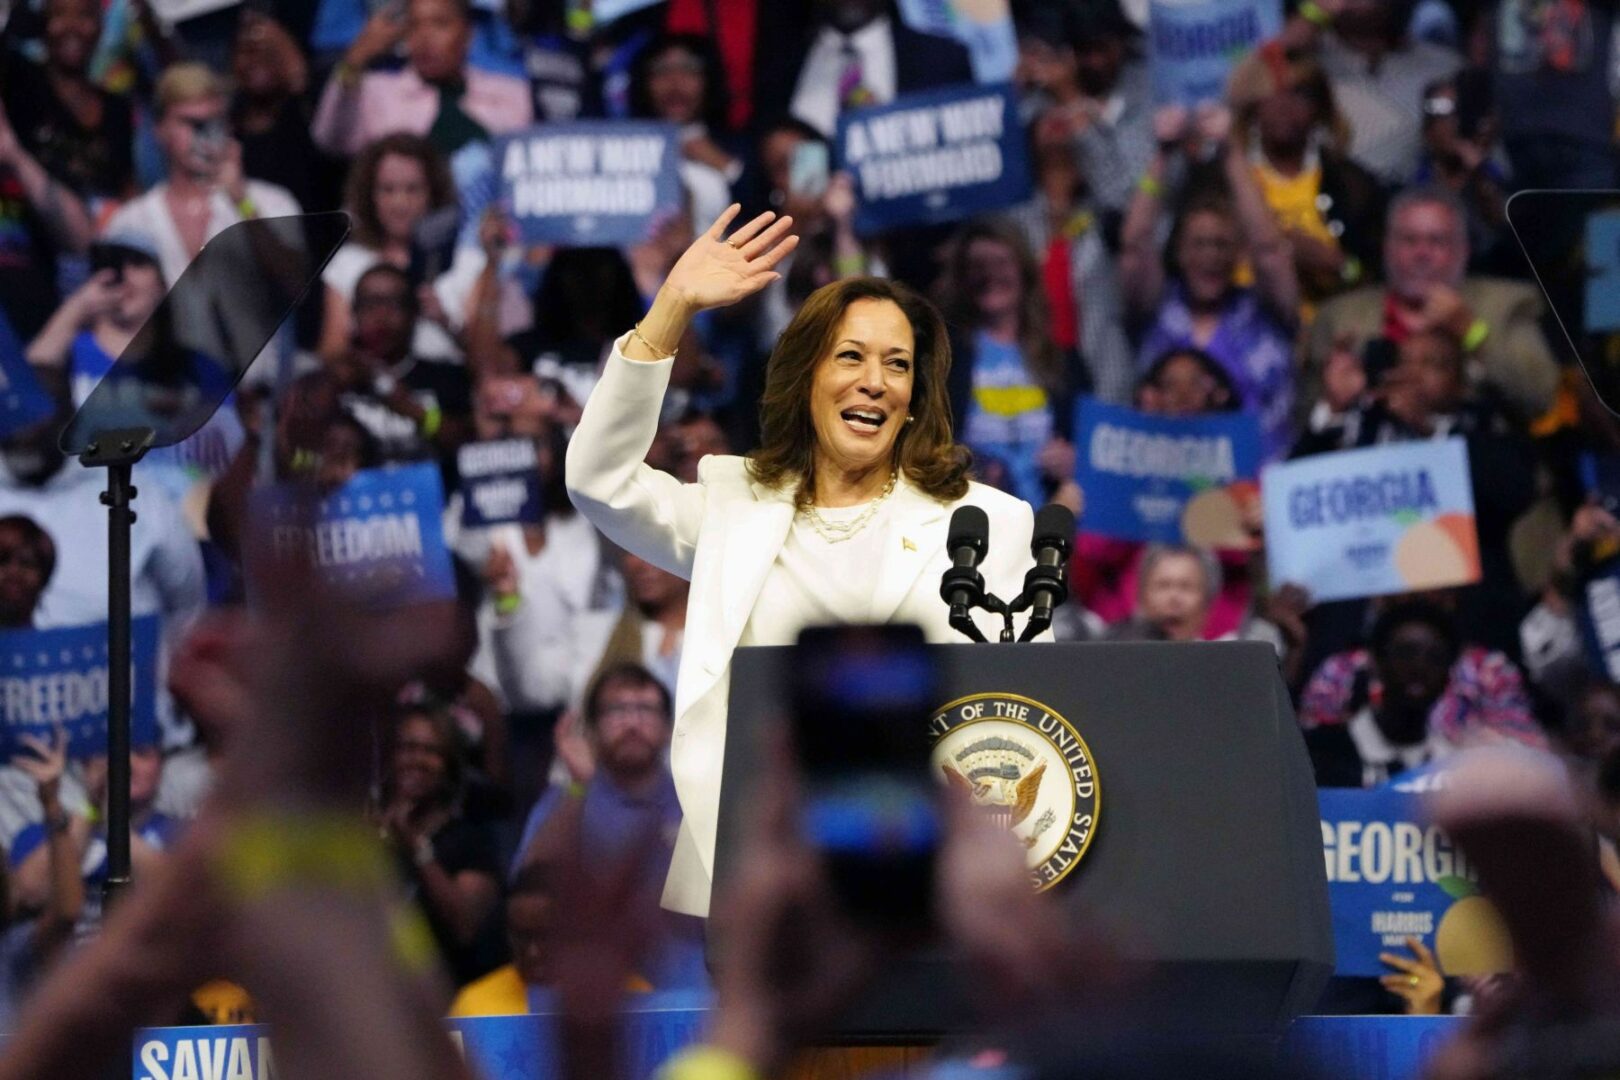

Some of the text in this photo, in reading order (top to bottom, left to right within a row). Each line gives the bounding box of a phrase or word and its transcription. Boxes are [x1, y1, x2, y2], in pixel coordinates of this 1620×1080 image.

[503, 139, 527, 180] A
[529, 135, 597, 173] NEW
[845, 122, 873, 165] A
[868, 108, 938, 154] NEW
[1090, 423, 1236, 482] GEORGIA
[1289, 467, 1437, 531] GEORGIA
[960, 702, 985, 721] OF
[993, 701, 1030, 722] THE
[1037, 713, 1095, 799] UNITED
[1030, 812, 1093, 889] STATES
[1320, 820, 1479, 884] GEORGI
[1371, 911, 1434, 934] HARRIS
